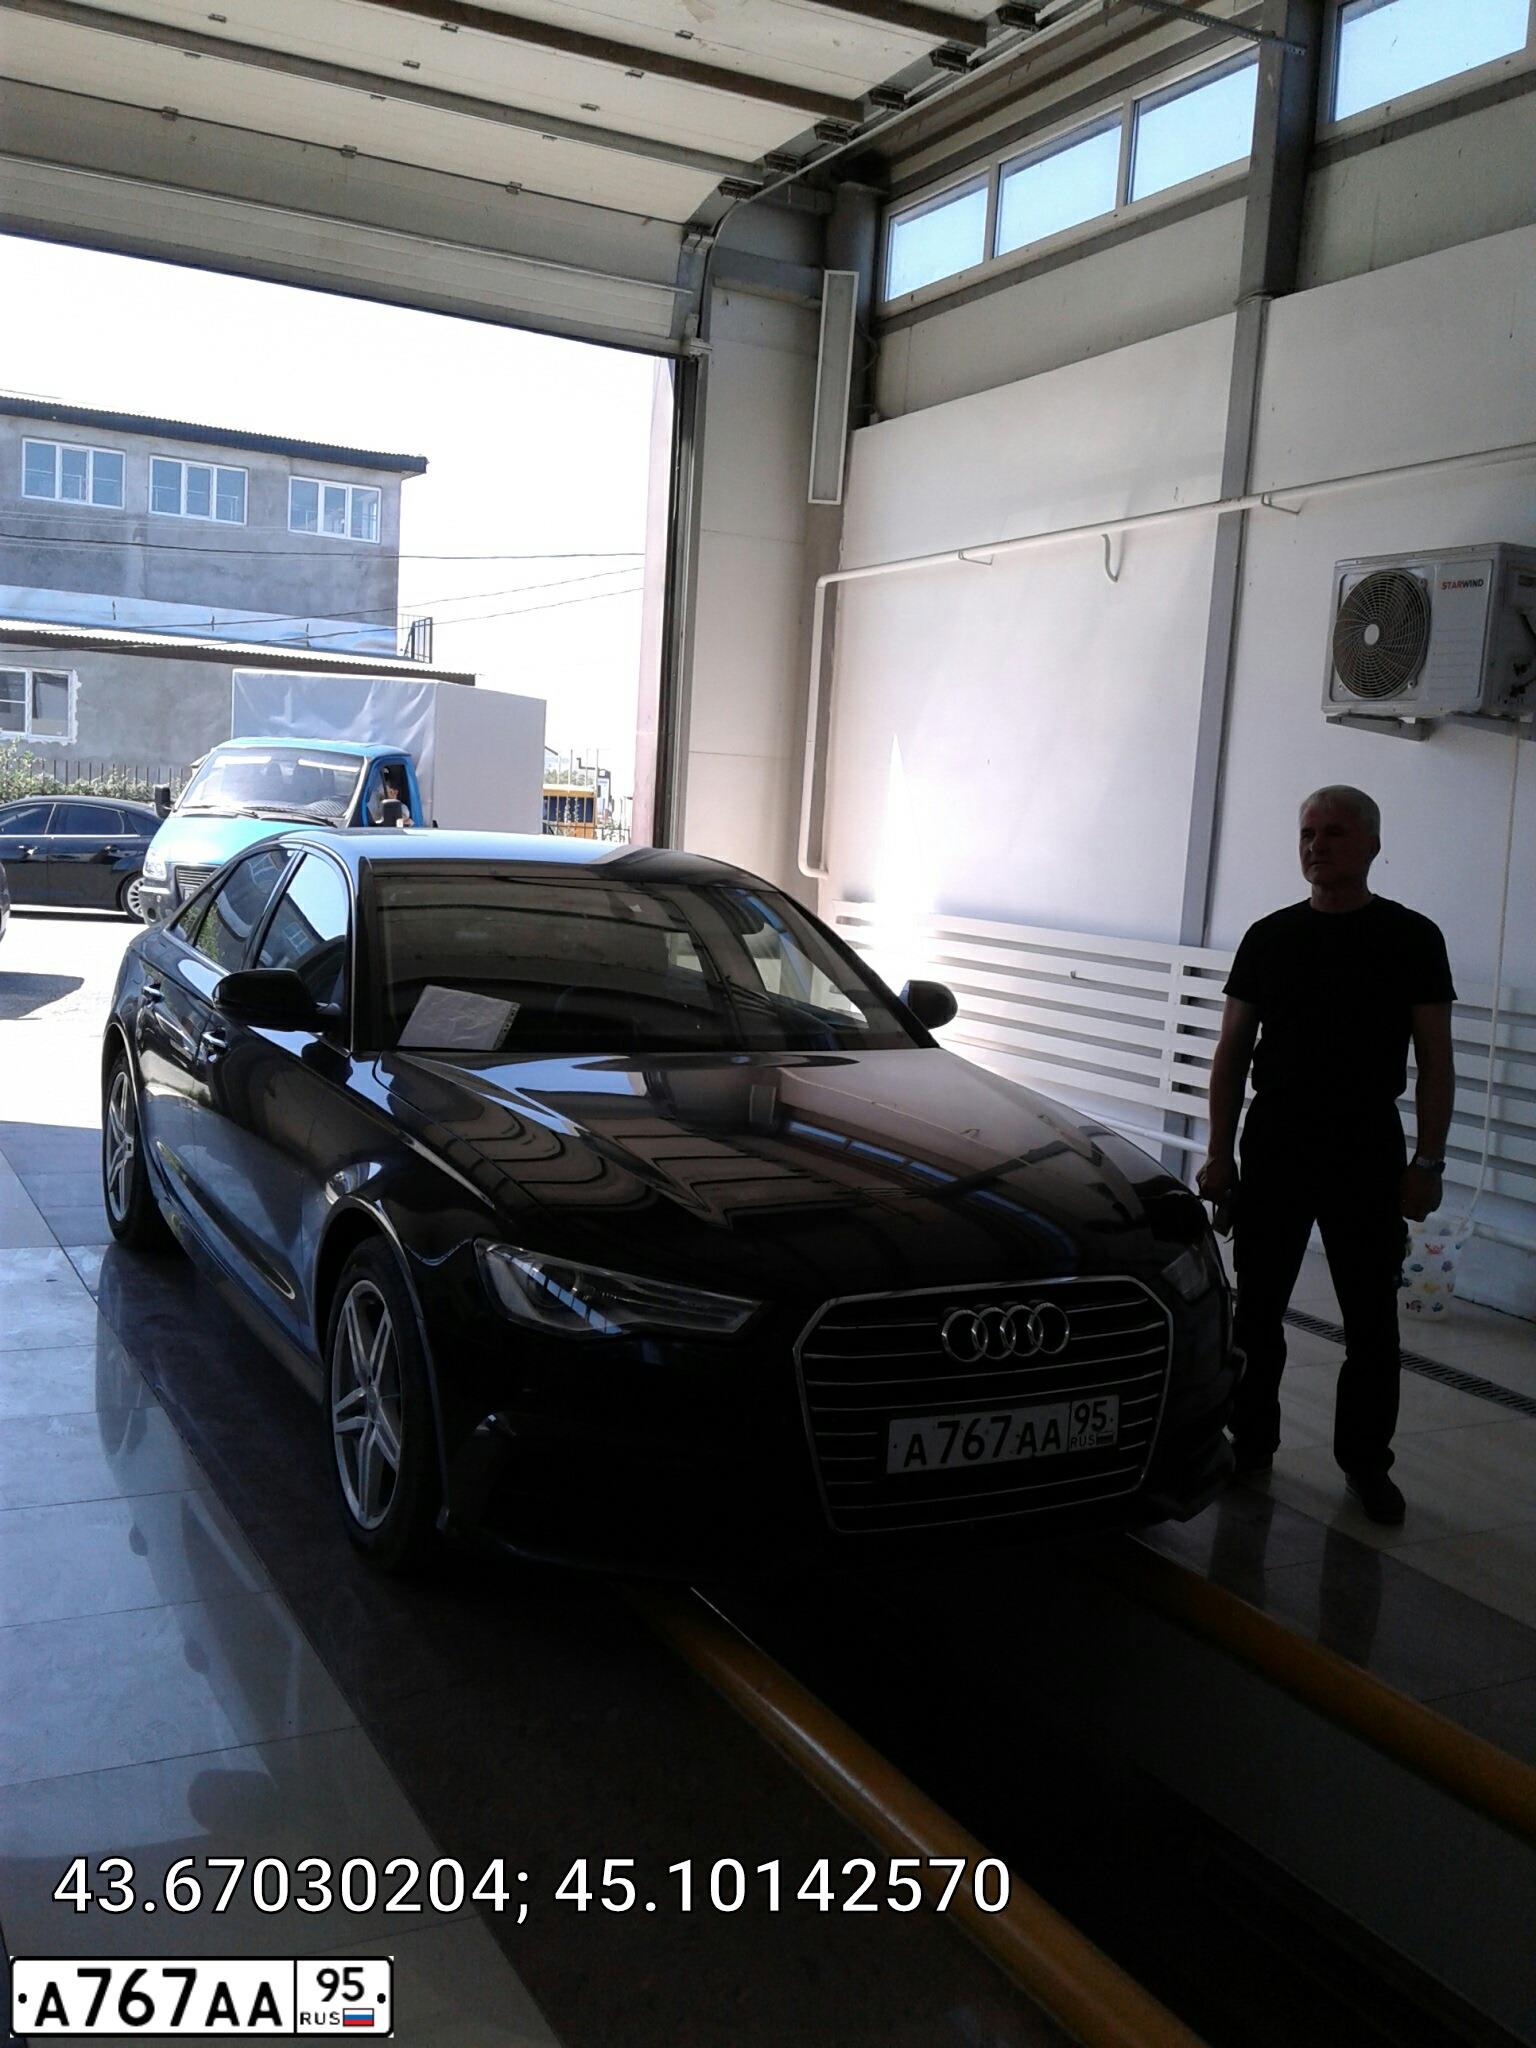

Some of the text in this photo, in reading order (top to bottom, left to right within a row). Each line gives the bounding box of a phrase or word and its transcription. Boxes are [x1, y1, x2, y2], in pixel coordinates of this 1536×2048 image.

[1441, 579, 1484, 590] STARWIND
[1074, 1400, 1108, 1434] 95
[1070, 1434, 1097, 1449] RUS
